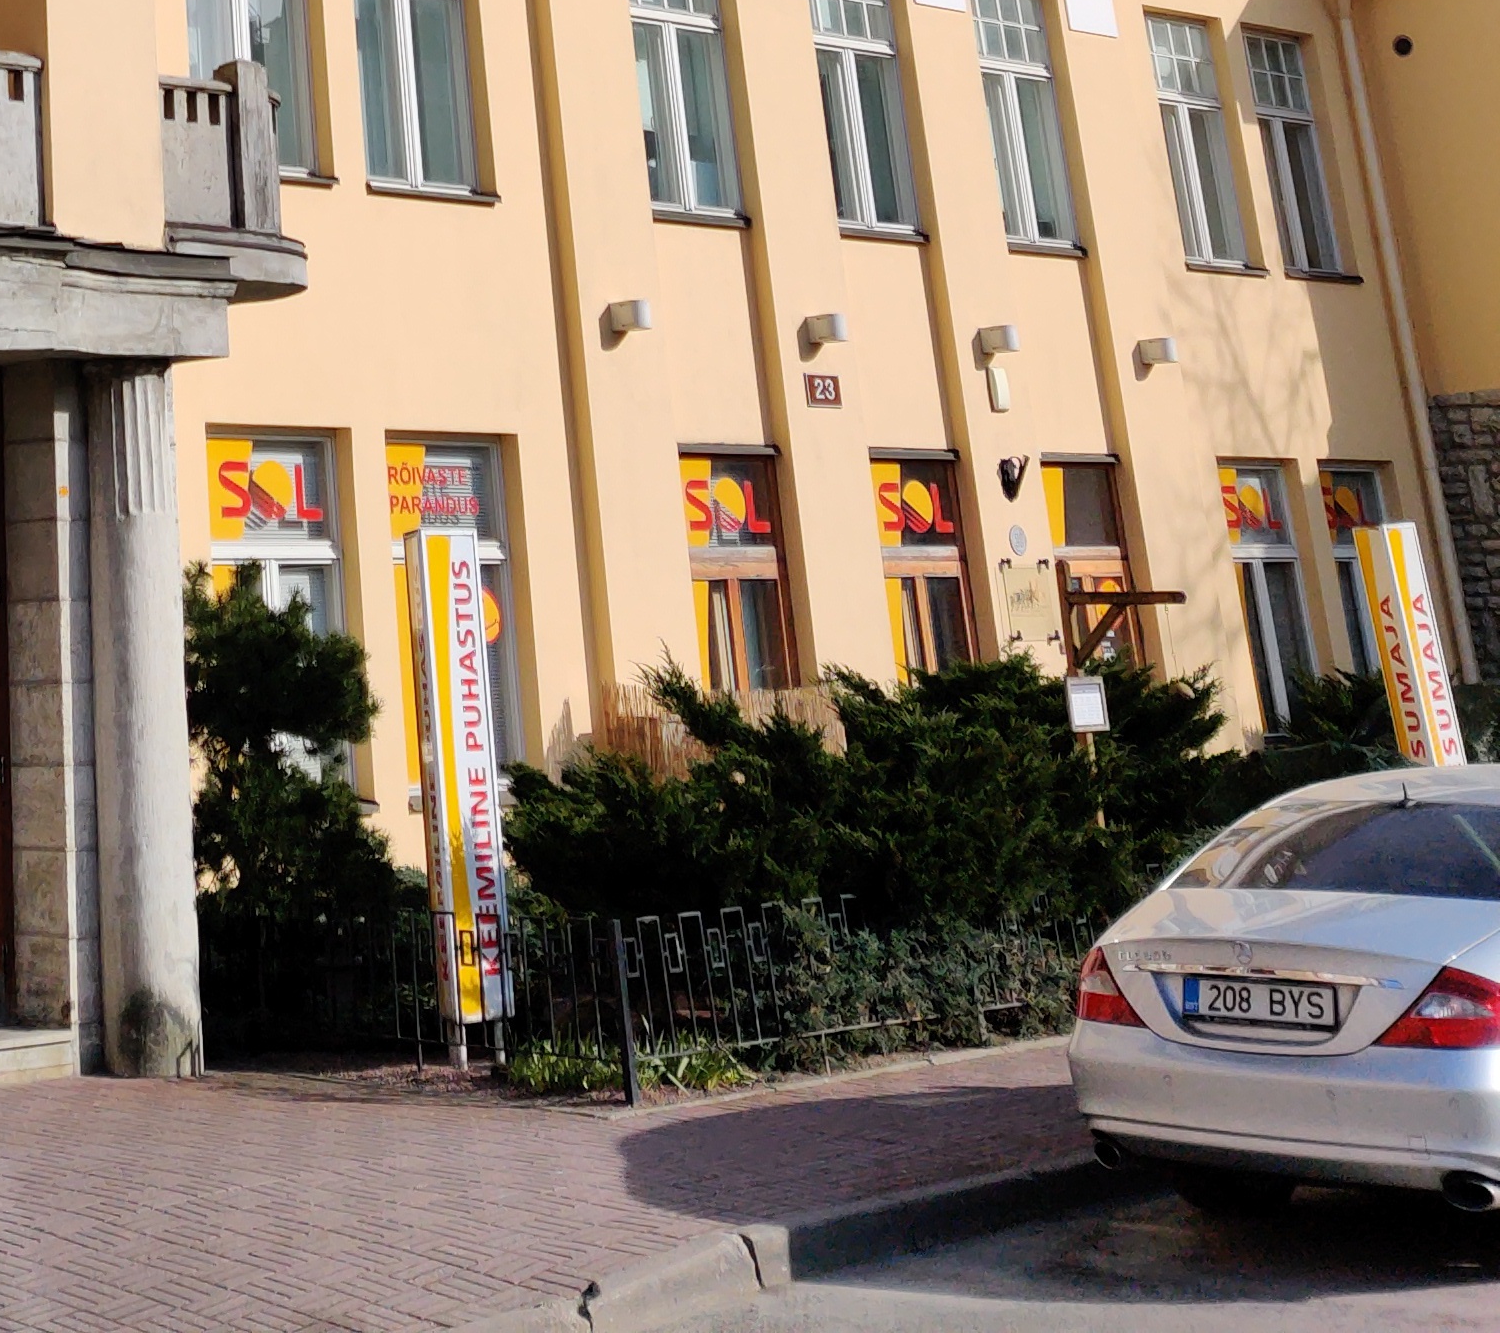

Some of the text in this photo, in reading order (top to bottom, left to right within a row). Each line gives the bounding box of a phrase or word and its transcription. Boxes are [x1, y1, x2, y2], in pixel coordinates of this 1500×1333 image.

[813, 377, 836, 401] 23
[218, 459, 324, 522] SOL
[387, 461, 468, 487] RÕIVASTE
[389, 494, 480, 517] PARANDUS
[685, 476, 772, 534] SOL
[878, 479, 955, 534] SOL
[1220, 484, 1283, 531] SOL
[1379, 594, 1428, 760] SUMAJA
[1412, 592, 1459, 758] SUMAJA
[451, 559, 502, 978] KEEMILINE PUHASTUS
[1207, 983, 1326, 1020] 208 BYS
